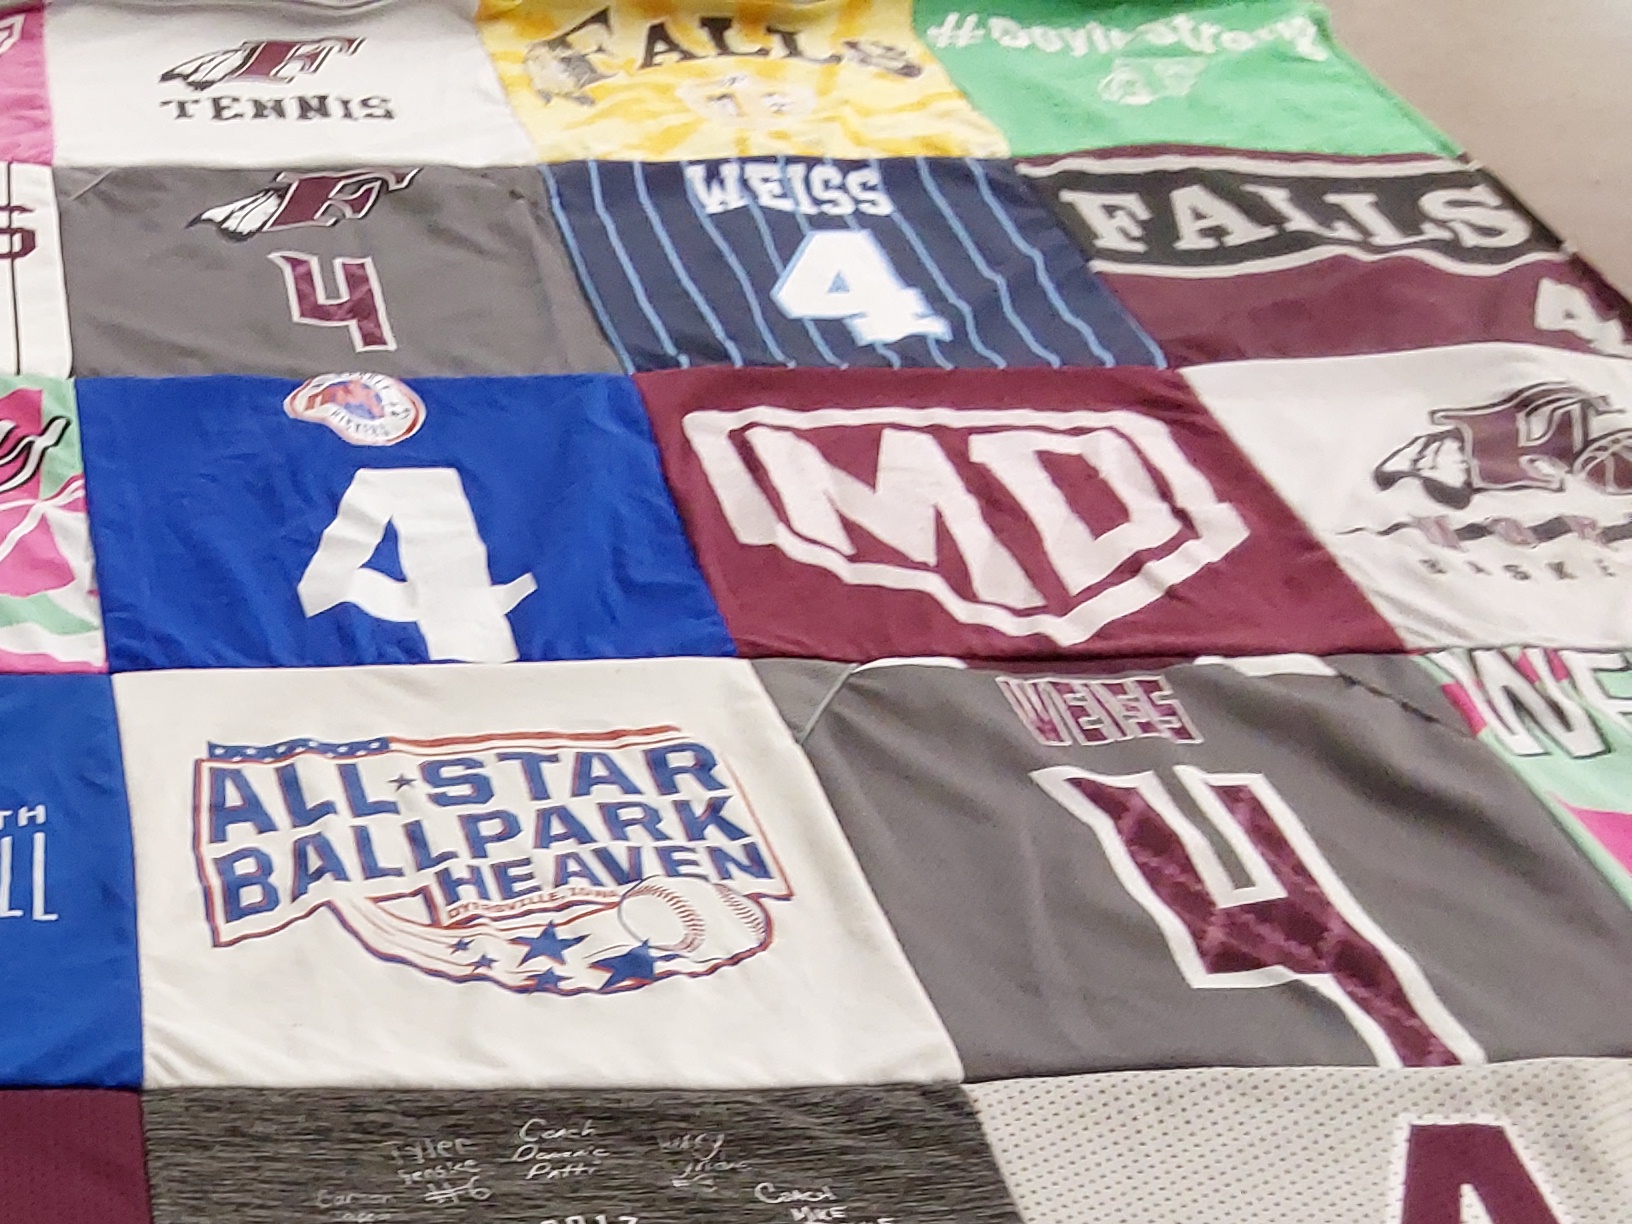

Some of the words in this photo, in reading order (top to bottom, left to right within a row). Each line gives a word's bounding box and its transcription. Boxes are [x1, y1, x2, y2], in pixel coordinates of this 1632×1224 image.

[160, 94, 396, 121] TENNIS
[683, 162, 896, 216] WEISS
[1059, 184, 1532, 254] FALLS
[268, 250, 397, 352] 4
[769, 229, 954, 347] 4
[742, 424, 1184, 613] MD
[296, 466, 539, 664] 4
[417, 741, 735, 808] STAR
[213, 794, 753, 925] BALLPARK
[433, 840, 776, 910] HEAVEN
[1028, 764, 1488, 1069] 4
[424, 1174, 494, 1204] #6
